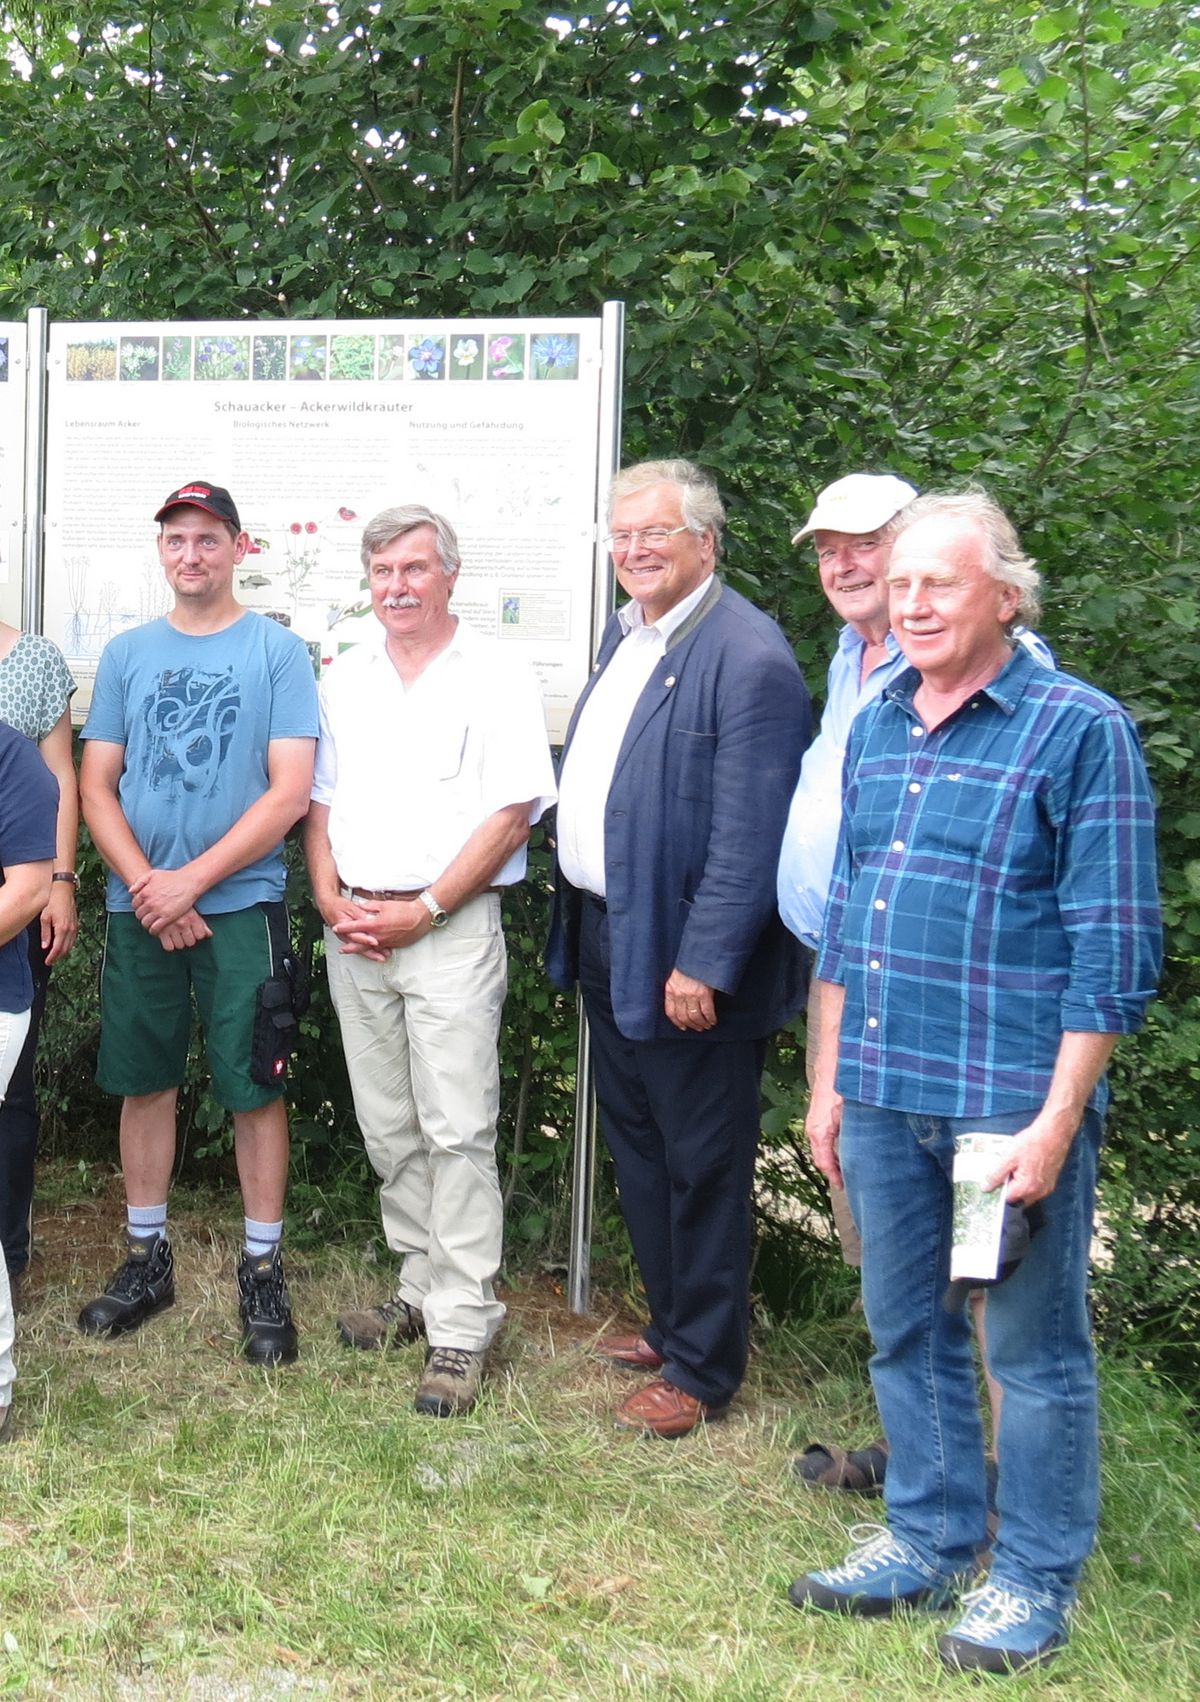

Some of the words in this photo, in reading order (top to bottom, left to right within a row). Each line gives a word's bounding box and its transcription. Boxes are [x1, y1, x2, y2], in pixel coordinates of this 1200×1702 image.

[214, 401, 286, 412] Schauacker
[300, 400, 414, 412] Ackerwildkräuter
[65, 420, 116, 428] Lebensraum
[117, 420, 141, 428] Acker
[233, 420, 287, 430] Biologisches
[289, 420, 331, 428] Netzwerk
[408, 421, 448, 430] Nutzung
[469, 421, 525, 430] Gefährdung
